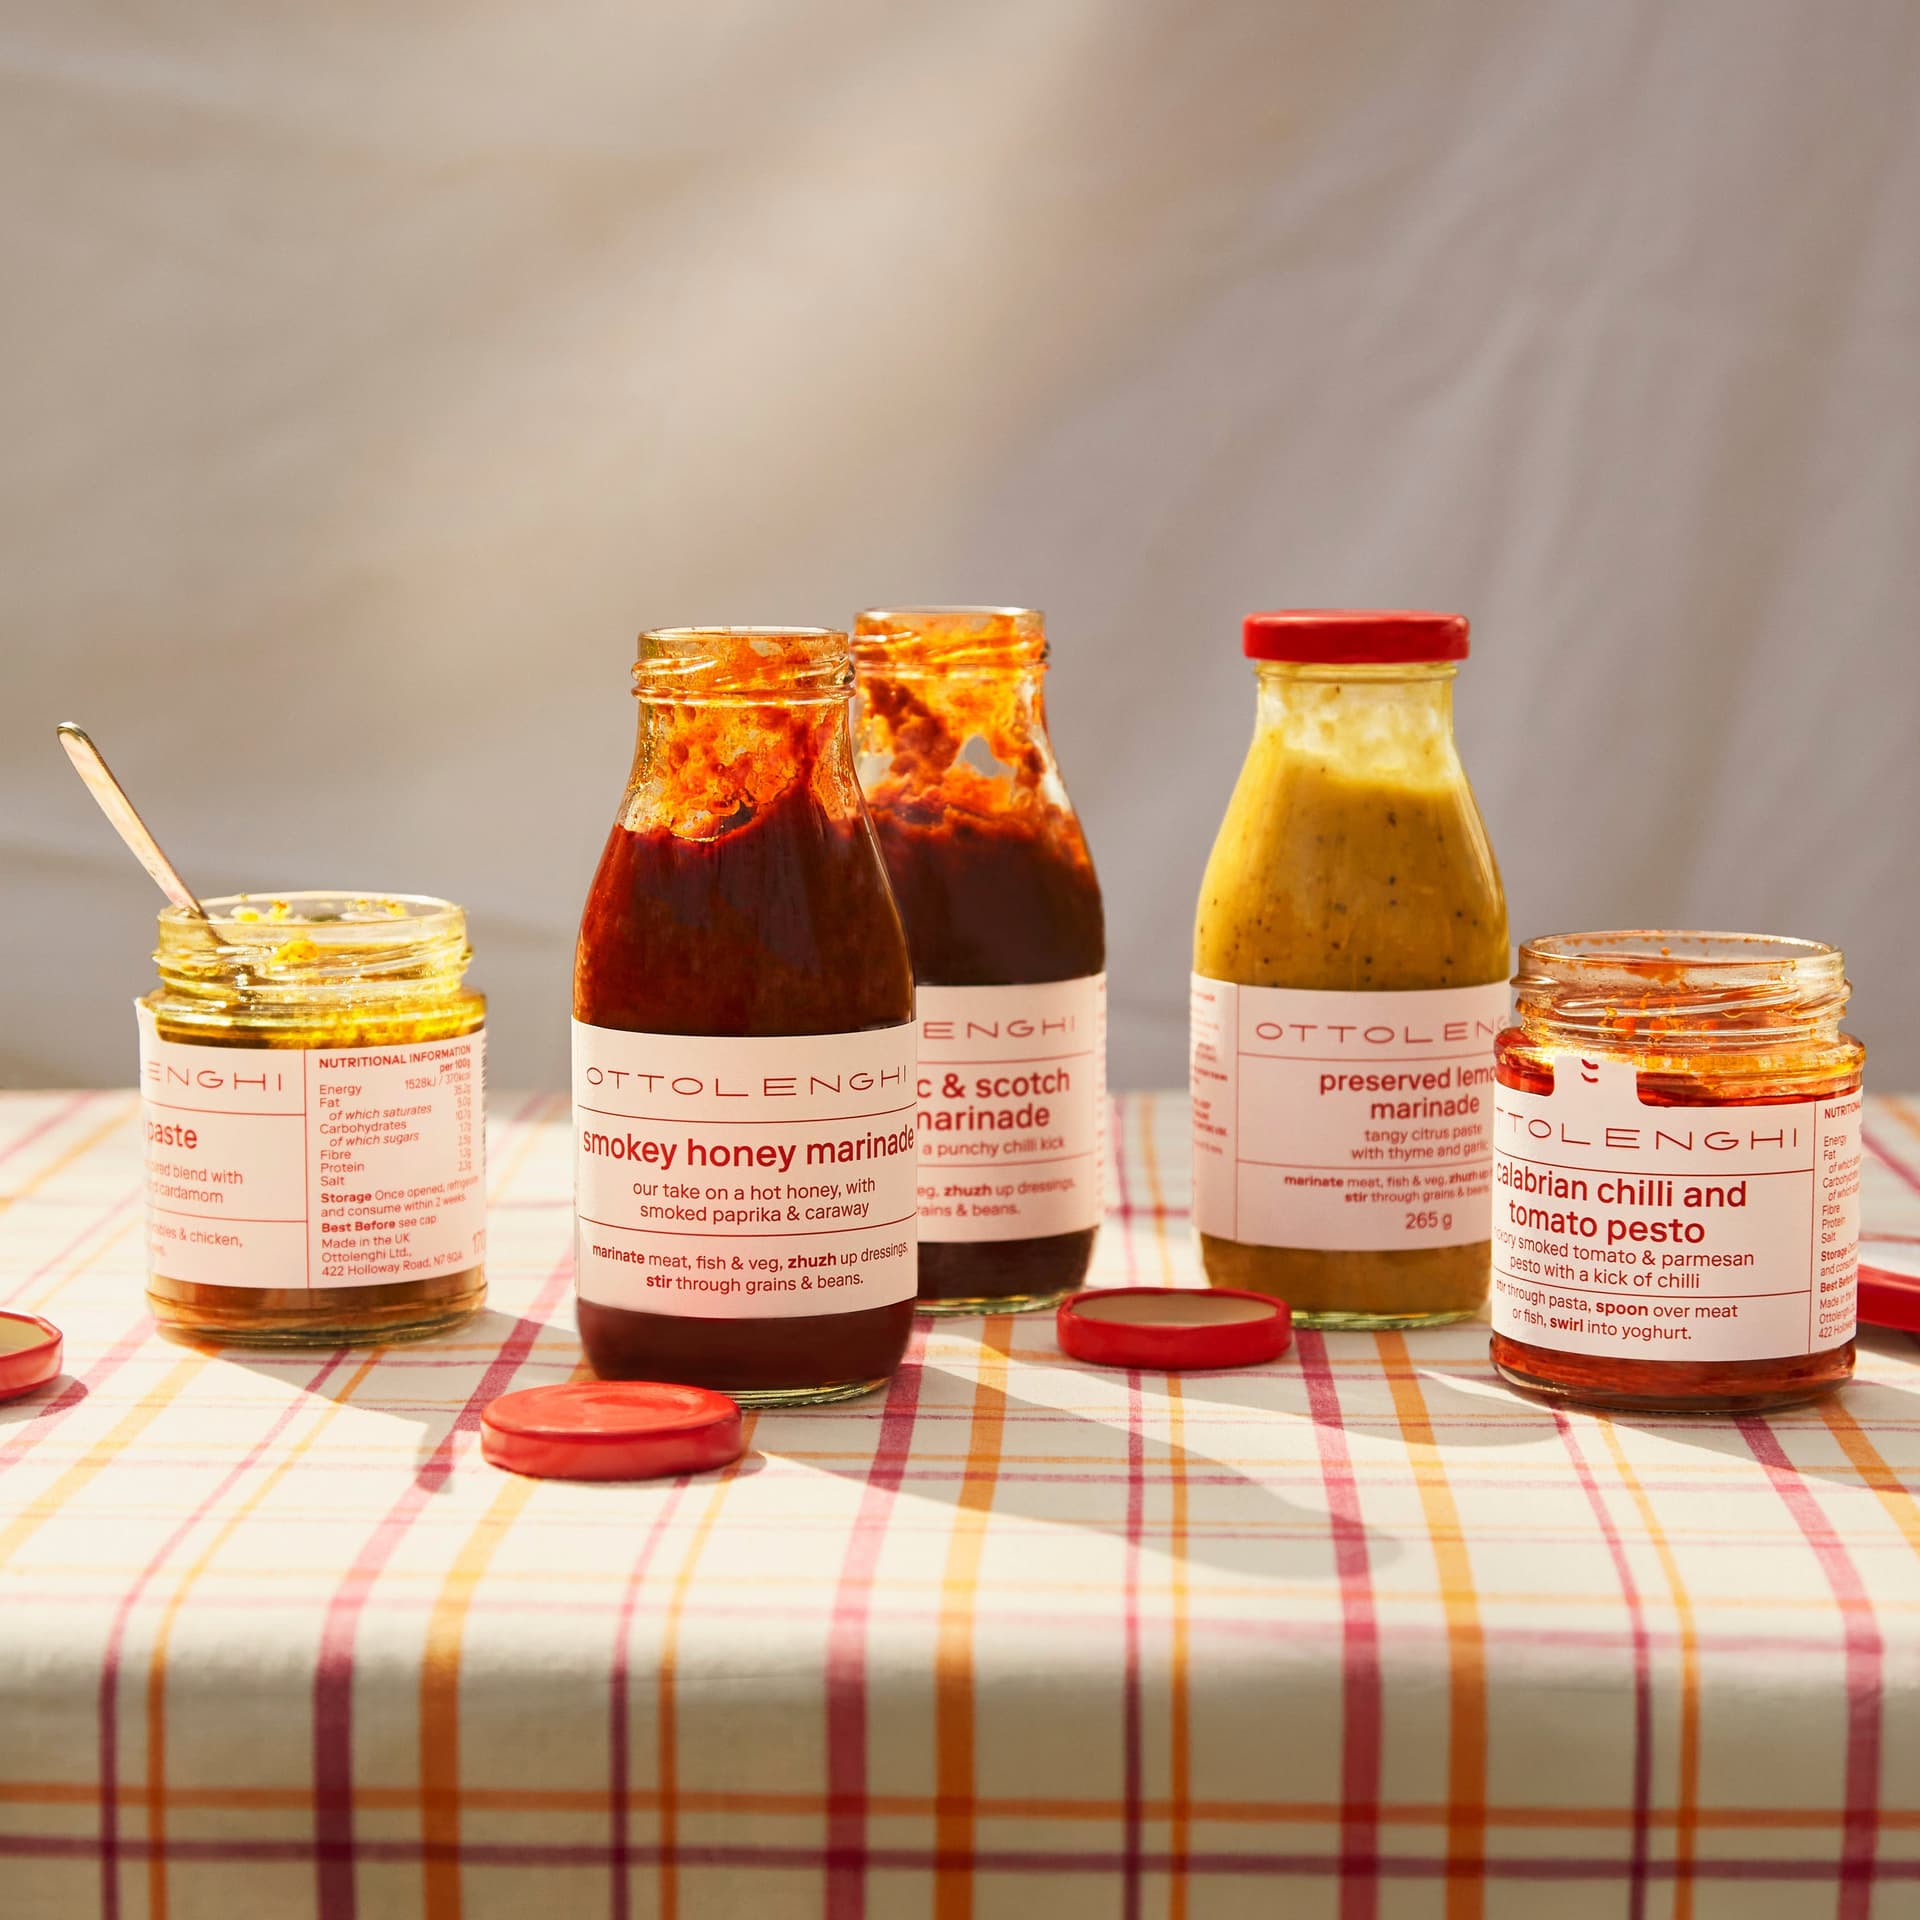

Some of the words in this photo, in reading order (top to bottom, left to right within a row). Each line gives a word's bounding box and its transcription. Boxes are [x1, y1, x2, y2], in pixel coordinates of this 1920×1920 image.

[924, 1016, 1075, 1040] ENGHI
[319, 1056, 408, 1069] NUTRITIONAL
[409, 1045, 471, 1064] INFORMATION
[439, 1062, 454, 1074] per
[455, 1058, 471, 1070] 100g
[148, 1061, 282, 1092] ENGHI
[586, 1065, 907, 1097] OTTOLENGHI
[942, 1073, 966, 1098] &
[976, 1068, 1070, 1098] scotch
[1319, 1067, 1451, 1096] preserved
[319, 1084, 363, 1097] Energy
[405, 1076, 437, 1090] 1528kJ
[319, 1097, 340, 1108] Fat
[1370, 1094, 1480, 1120] marinade
[329, 1110, 343, 1121] of
[345, 1108, 380, 1120] which
[382, 1104, 432, 1118] saturates
[319, 1121, 408, 1135] Carbohydrates
[1364, 1128, 1408, 1144] tangy
[1412, 1126, 1450, 1141] citrus
[1453, 1124, 1483, 1141] paste
[329, 1137, 343, 1148] of
[345, 1134, 380, 1147] which
[383, 1132, 420, 1147] sugars
[583, 1129, 677, 1171] smokey
[687, 1138, 797, 1173] honey
[806, 1124, 914, 1165] marinade
[923, 1143, 932, 1156] a
[937, 1139, 999, 1157] punchy
[1003, 1136, 1037, 1154] chilli
[1040, 1135, 1064, 1150] kick
[320, 1150, 352, 1160] Fibre
[1351, 1147, 1384, 1161] with
[1388, 1146, 1434, 1162] thyme
[1437, 1144, 1461, 1157] and
[1823, 1149, 1836, 1161] Fat
[173, 1166, 207, 1182] blend
[210, 1169, 244, 1185] with
[320, 1162, 365, 1173] Protein
[320, 1176, 345, 1187] Salt
[1284, 1174, 1344, 1188] marinate
[1347, 1176, 1384, 1189] meat,
[1387, 1175, 1409, 1188] fish
[1412, 1175, 1422, 1187] &
[1496, 1161, 1588, 1202] calabrian
[1597, 1178, 1673, 1207] chilli
[1683, 1181, 1747, 1208] and
[159, 1184, 224, 1204] cardamom
[321, 1192, 372, 1204] Storage
[374, 1189, 405, 1202] Once
[632, 1182, 658, 1197] our
[662, 1183, 700, 1200] take
[705, 1187, 728, 1201] on
[733, 1188, 744, 1201] a
[751, 1185, 781, 1200] hot
[786, 1184, 842, 1204] honey,
[846, 1178, 876, 1195] with
[944, 1184, 992, 1197] zhuzh
[995, 1185, 1014, 1199] up
[1345, 1192, 1368, 1203] stir
[1371, 1190, 1420, 1205] through
[1423, 1190, 1455, 1205] grains
[1457, 1187, 1464, 1198] &
[321, 1207, 345, 1218] and
[347, 1204, 401, 1217] consume
[404, 1200, 434, 1212] within
[436, 1197, 441, 1208] 2
[640, 1205, 707, 1222] smoked
[712, 1207, 781, 1226] paprika
[786, 1206, 800, 1221] &
[805, 1202, 870, 1222] caraway
[956, 1203, 967, 1217] &
[972, 1203, 1021, 1217] beans.
[1822, 1204, 1840, 1217] Fibre
[321, 1223, 352, 1233] Best
[355, 1220, 396, 1232] Before
[398, 1218, 418, 1229] see
[419, 1215, 437, 1226] cap
[1405, 1212, 1438, 1229] 265
[1442, 1214, 1452, 1230] g
[1509, 1199, 1598, 1237] tomato
[1607, 1218, 1706, 1245] pesto
[179, 1228, 187, 1241] &
[190, 1231, 244, 1249] chicken,
[321, 1237, 356, 1249] Made
[359, 1236, 370, 1247] in
[373, 1235, 392, 1246] the
[394, 1232, 410, 1244] UK
[1821, 1232, 1837, 1244] Salt
[321, 1250, 387, 1264] Ottolenghi
[592, 1244, 645, 1265] marinate
[648, 1254, 692, 1271] meat,
[696, 1255, 726, 1270] fish
[732, 1257, 744, 1270] &
[748, 1258, 783, 1273] veg,
[787, 1252, 837, 1269] zhuzh
[841, 1252, 858, 1267] up
[1518, 1236, 1569, 1258] smoked
[1573, 1244, 1637, 1265] tomato
[1642, 1250, 1656, 1266] &
[1661, 1252, 1754, 1270] parmesan
[1821, 1247, 1847, 1262] Storage
[321, 1265, 345, 1276] 422
[347, 1261, 401, 1276] Holloway
[1510, 1255, 1541, 1275] pesto
[1544, 1263, 1575, 1281] with
[1579, 1269, 1589, 1282] a
[1593, 1267, 1628, 1286] kick
[1633, 1272, 1652, 1287] of
[1656, 1272, 1701, 1289] chilli
[1820, 1265, 1835, 1277] and
[646, 1275, 672, 1289] stir
[675, 1276, 741, 1295] through
[745, 1277, 796, 1295] grains
[801, 1275, 813, 1289] &
[817, 1271, 864, 1289] beans.
[1820, 1280, 1838, 1293] Best
[1507, 1282, 1546, 1306] through
[1549, 1294, 1592, 1313] pasta,
[1595, 1301, 1649, 1320] spoon
[1652, 1305, 1690, 1318] over
[1695, 1303, 1738, 1318] meat
[1820, 1297, 1839, 1310] Made
[1512, 1307, 1522, 1319] or
[1523, 1308, 1547, 1328] fish,
[1549, 1316, 1583, 1333] swirl
[1587, 1319, 1617, 1335] into
[1621, 1324, 1693, 1342] yoghurt.
[1818, 1326, 1832, 1339] 422
